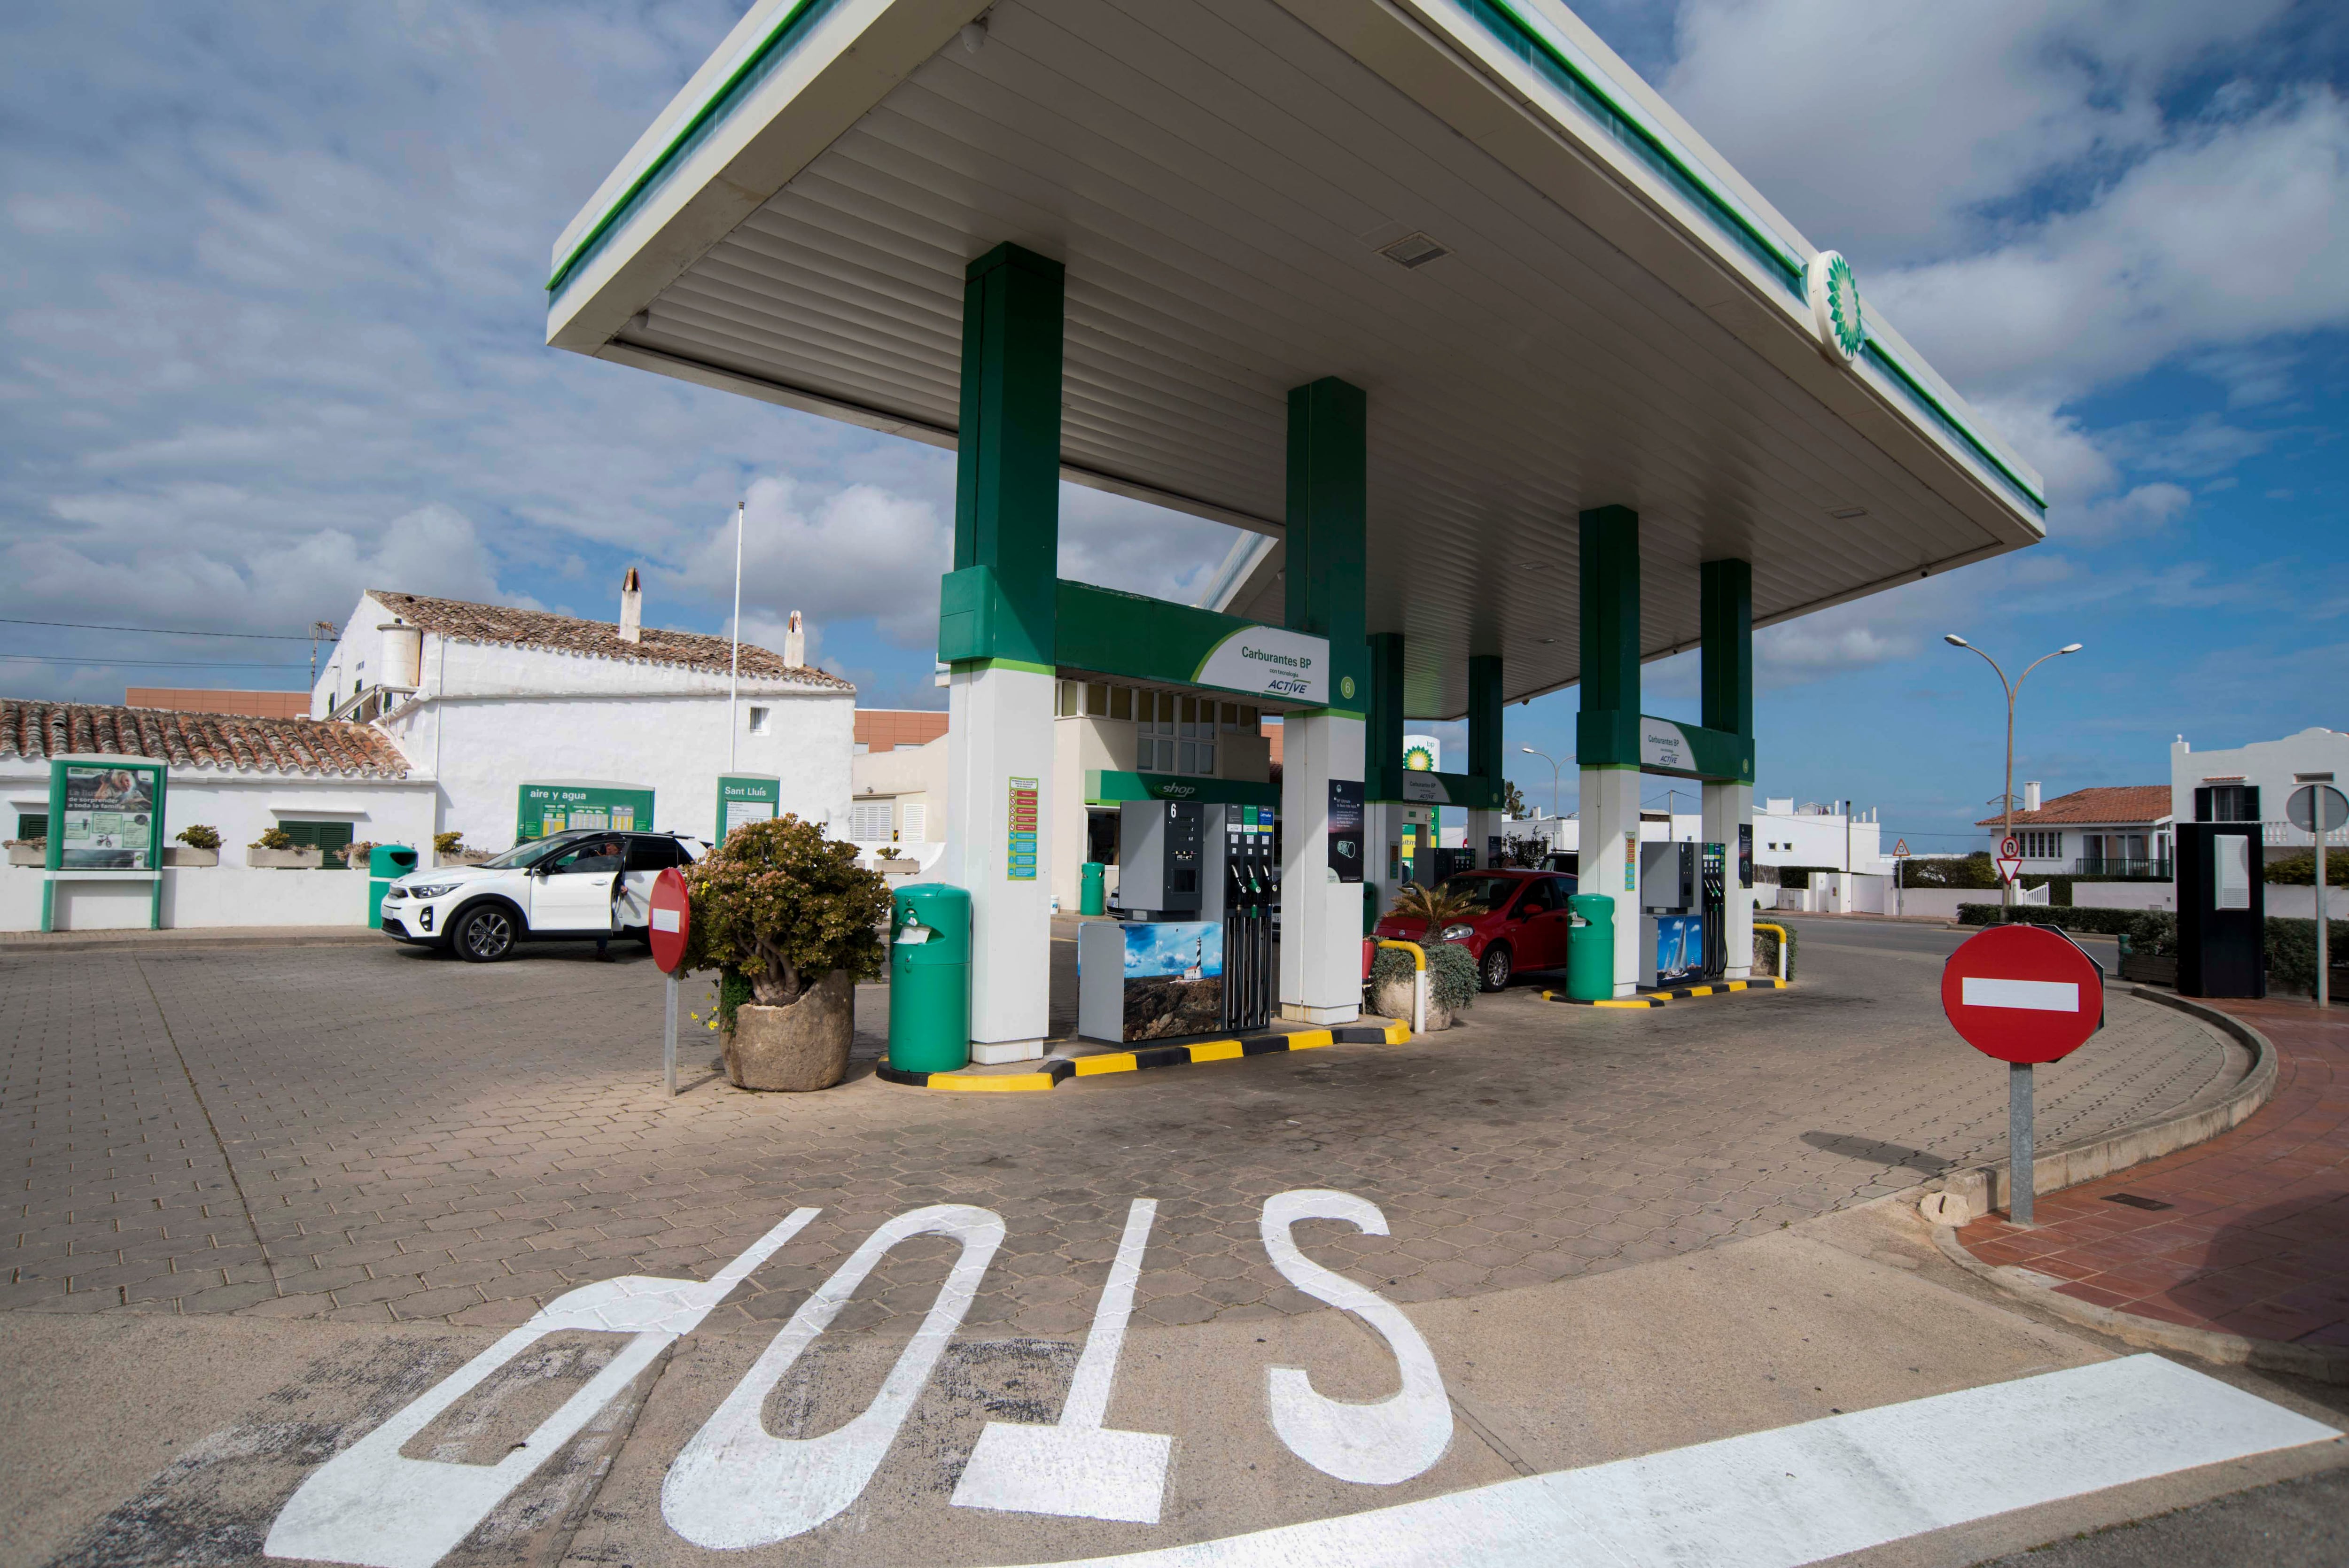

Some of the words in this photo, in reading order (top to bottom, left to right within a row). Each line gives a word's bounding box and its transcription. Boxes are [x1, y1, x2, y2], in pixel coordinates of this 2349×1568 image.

[1242, 646, 1298, 667] Carburantes
[1300, 657, 1312, 669] BP
[1268, 680, 1307, 693] ACTIVE
[1345, 682, 1351, 693] 6
[1648, 735, 1673, 746] Carburantes
[1660, 755, 1678, 764] ACTIVE
[530, 789, 549, 798] aire
[552, 792, 559, 800] y
[562, 792, 586, 801] agua
[725, 786, 745, 795] Sant
[747, 787, 766, 796] Lluís
[1163, 782, 1195, 797] shop
[1171, 803, 1176, 818] 6
[264, 1188, 1455, 1568] STOP
